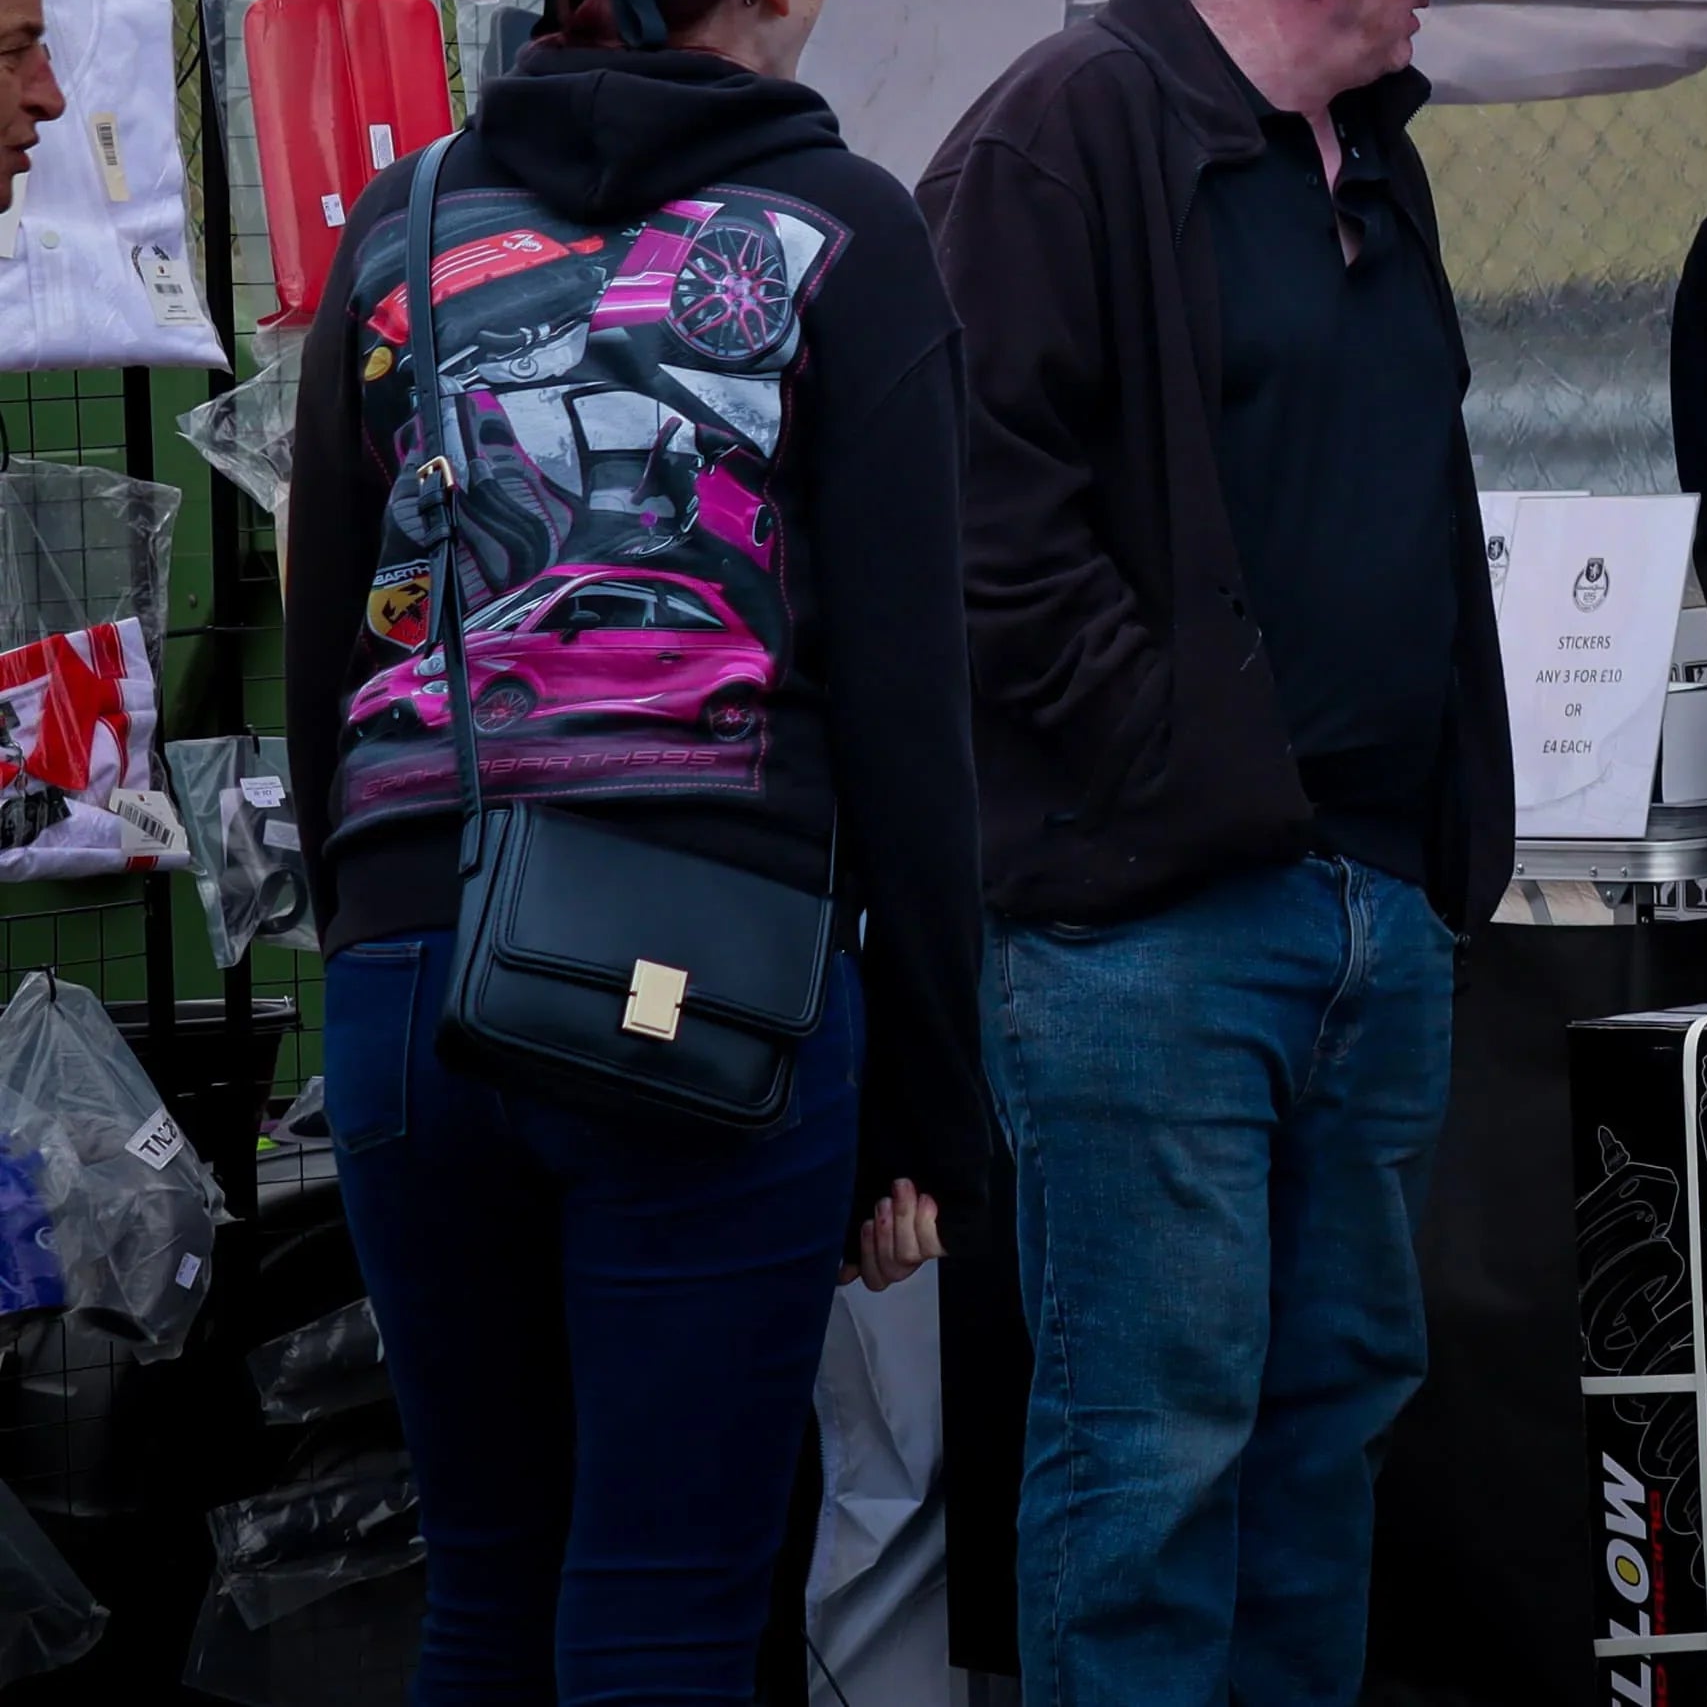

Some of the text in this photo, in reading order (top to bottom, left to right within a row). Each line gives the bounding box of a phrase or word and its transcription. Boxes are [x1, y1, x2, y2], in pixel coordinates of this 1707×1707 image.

[1558, 635, 1611, 650] STICKERS
[1536, 669, 1622, 684] ANY 3 FOR £10
[1564, 703, 1582, 717] OR
[1543, 740, 1592, 755] £4 EACH
